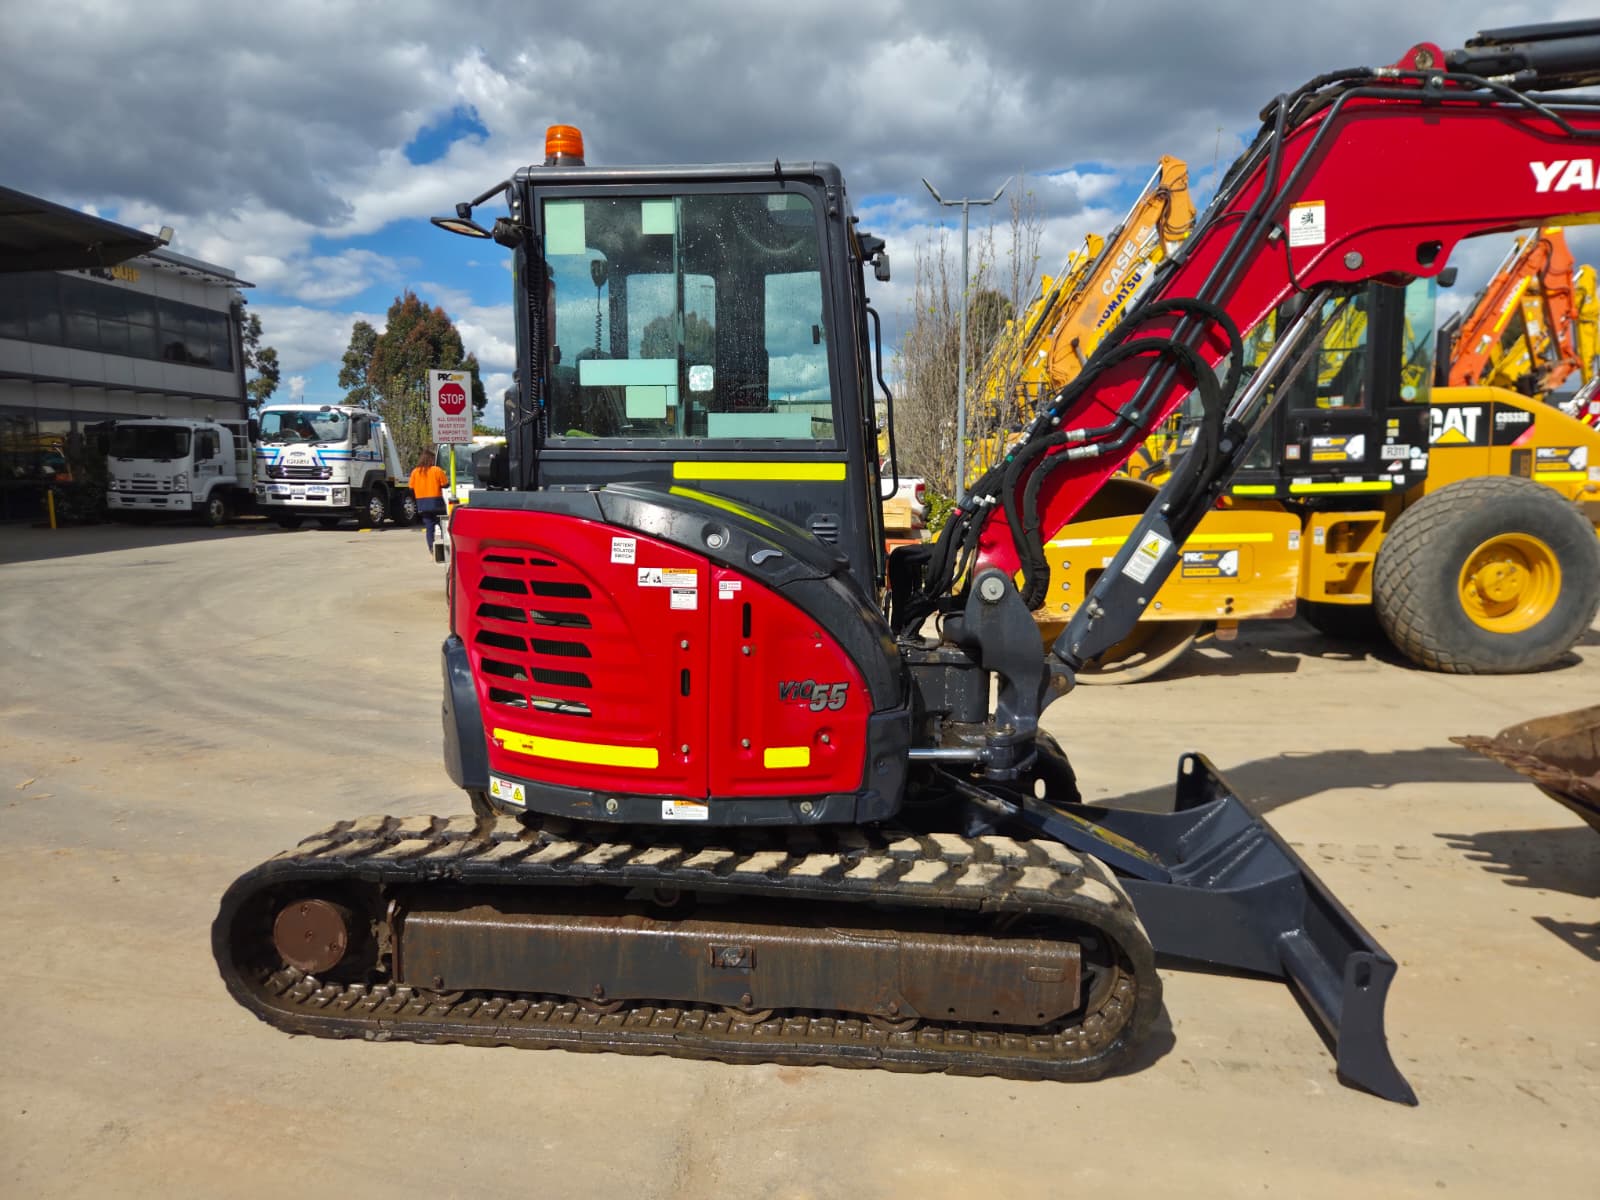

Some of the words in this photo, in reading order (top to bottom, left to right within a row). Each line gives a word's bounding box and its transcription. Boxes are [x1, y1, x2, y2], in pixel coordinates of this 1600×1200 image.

[1529, 158, 1600, 192] YA
[1102, 239, 1136, 296] CASE
[440, 393, 464, 405] STOP
[1429, 407, 1482, 444] CAT
